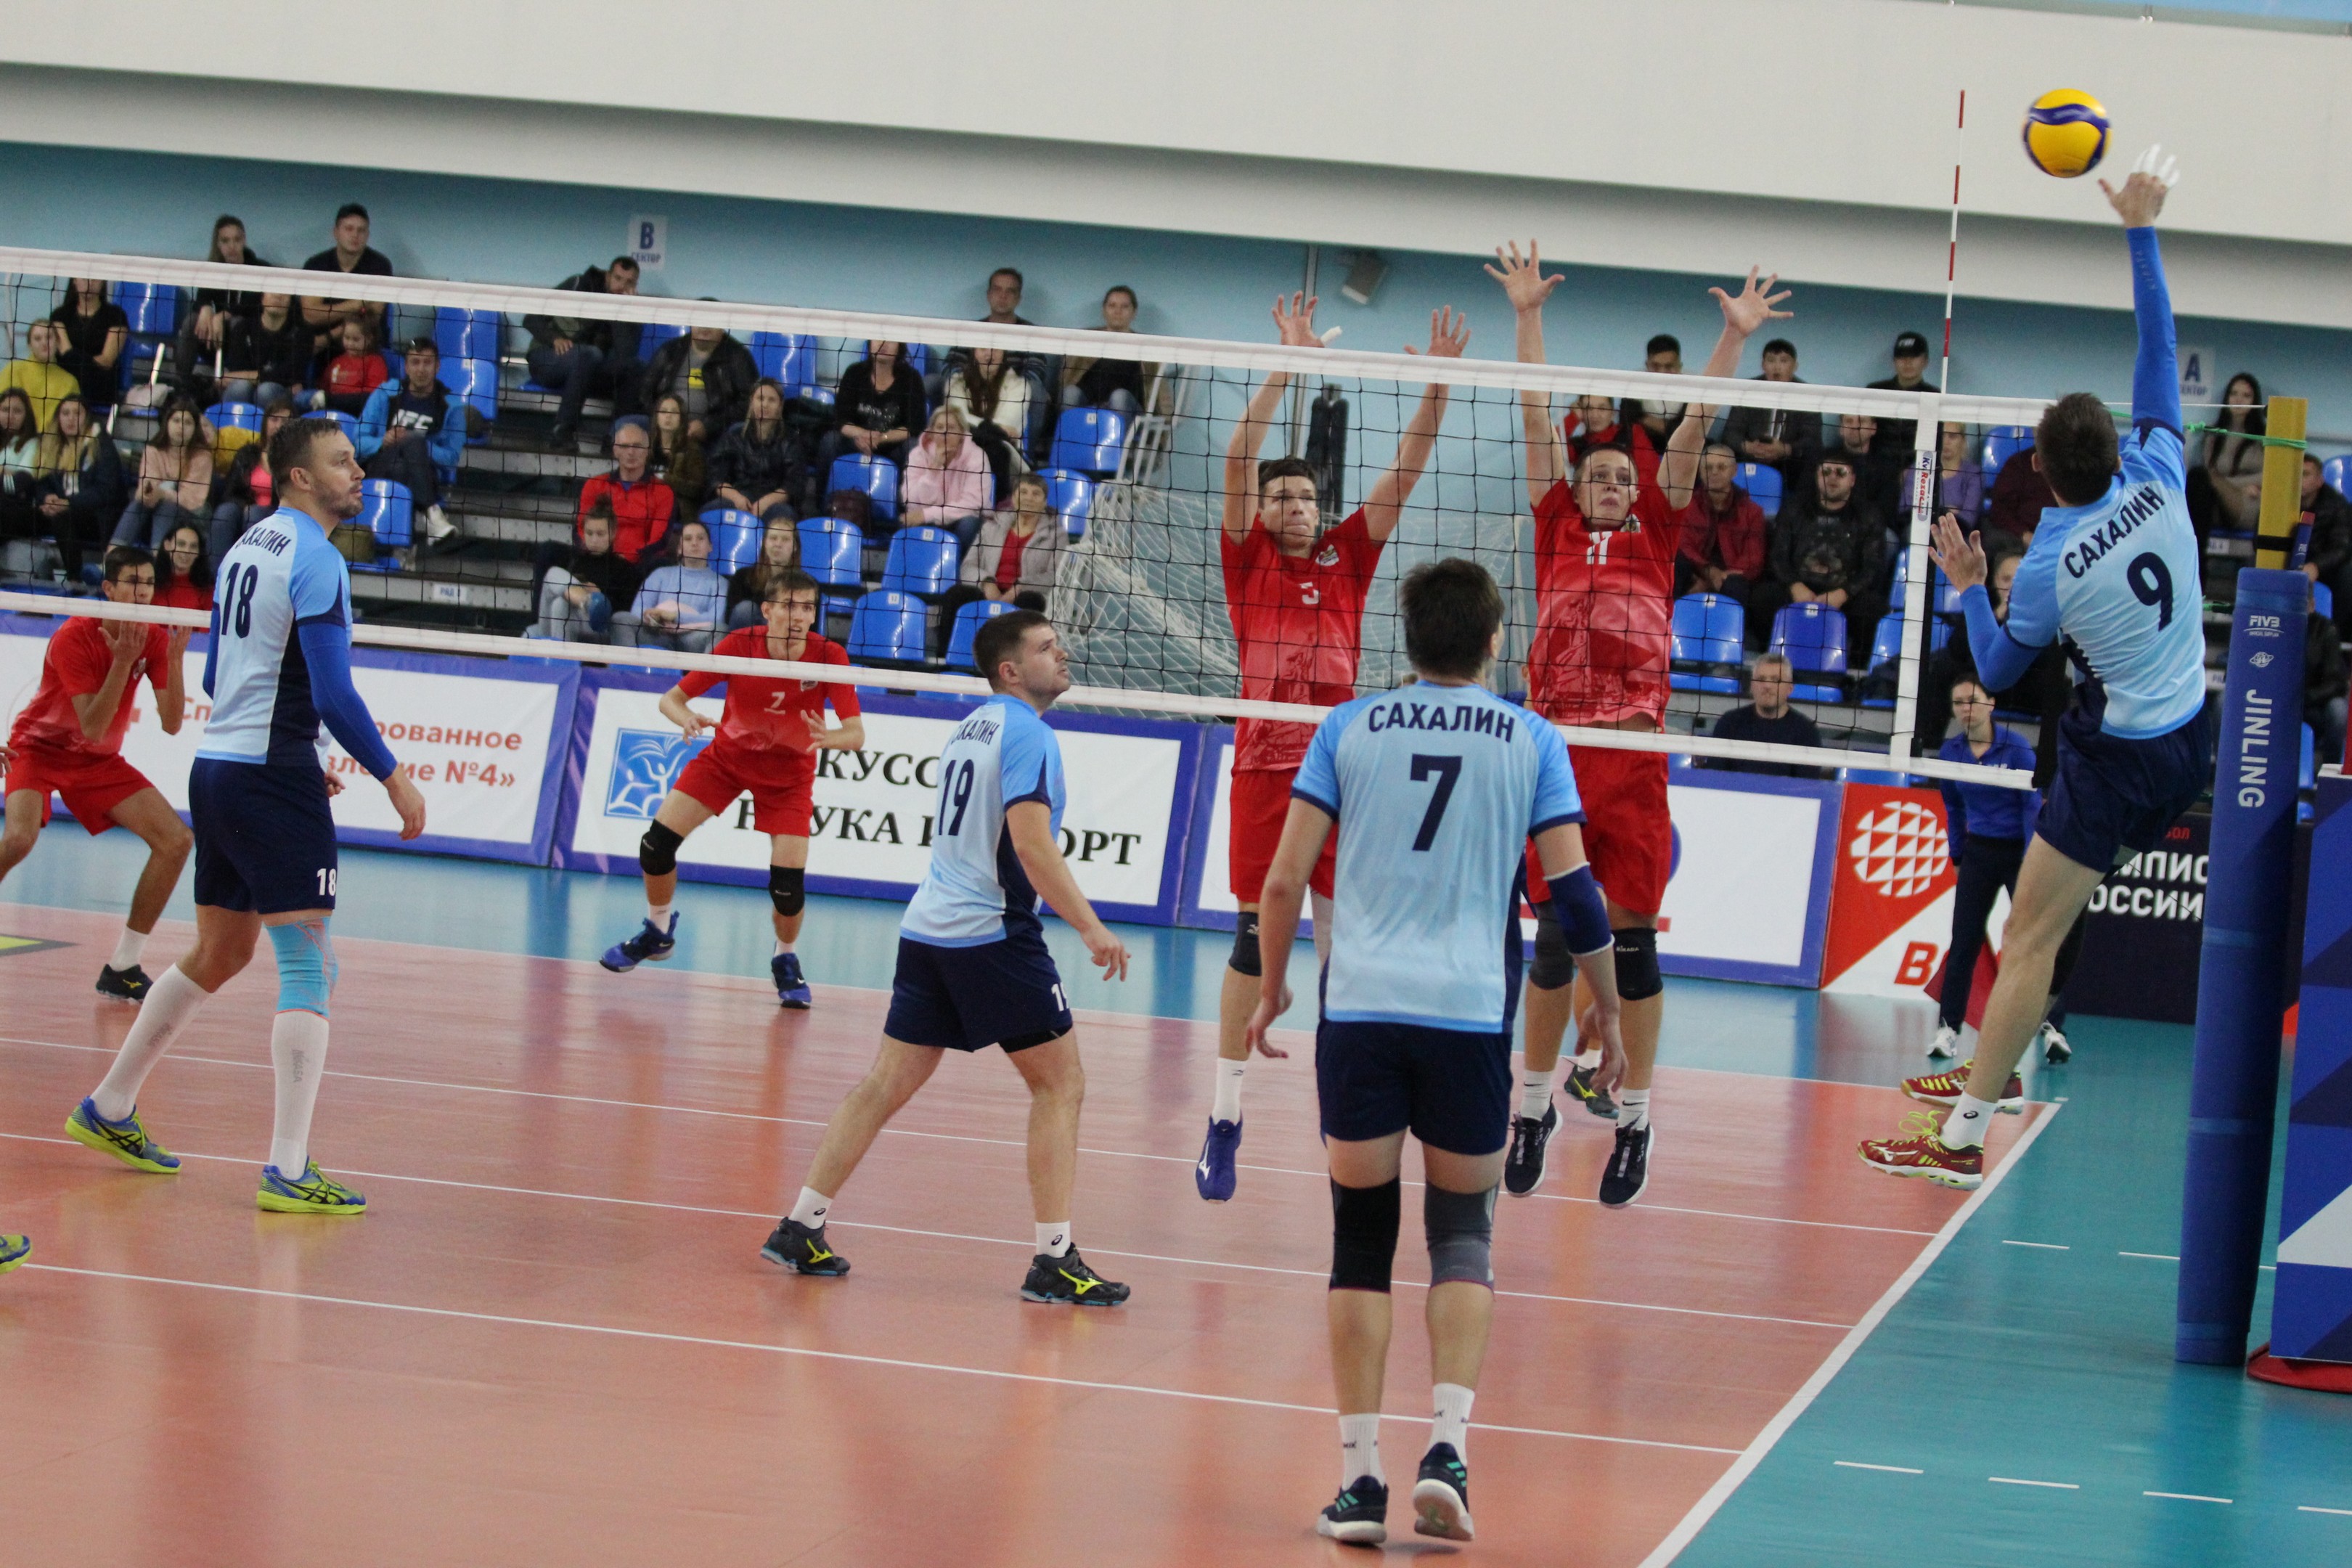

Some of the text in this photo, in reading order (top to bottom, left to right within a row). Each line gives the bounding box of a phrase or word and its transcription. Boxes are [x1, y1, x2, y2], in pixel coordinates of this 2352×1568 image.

[234, 526, 292, 556] АХАЛИН
[2065, 486, 2165, 579] САХАЛИН
[221, 562, 258, 639] 18
[2127, 552, 2173, 632] 9
[2250, 615, 2280, 627] FIVB
[1368, 702, 1515, 743] САХАЛИН
[2237, 689, 2273, 808] JINLING
[939, 759, 974, 836] 19
[1410, 754, 1463, 852] 7
[317, 868, 337, 897] 18
[2088, 883, 2204, 922] ОССИИ
